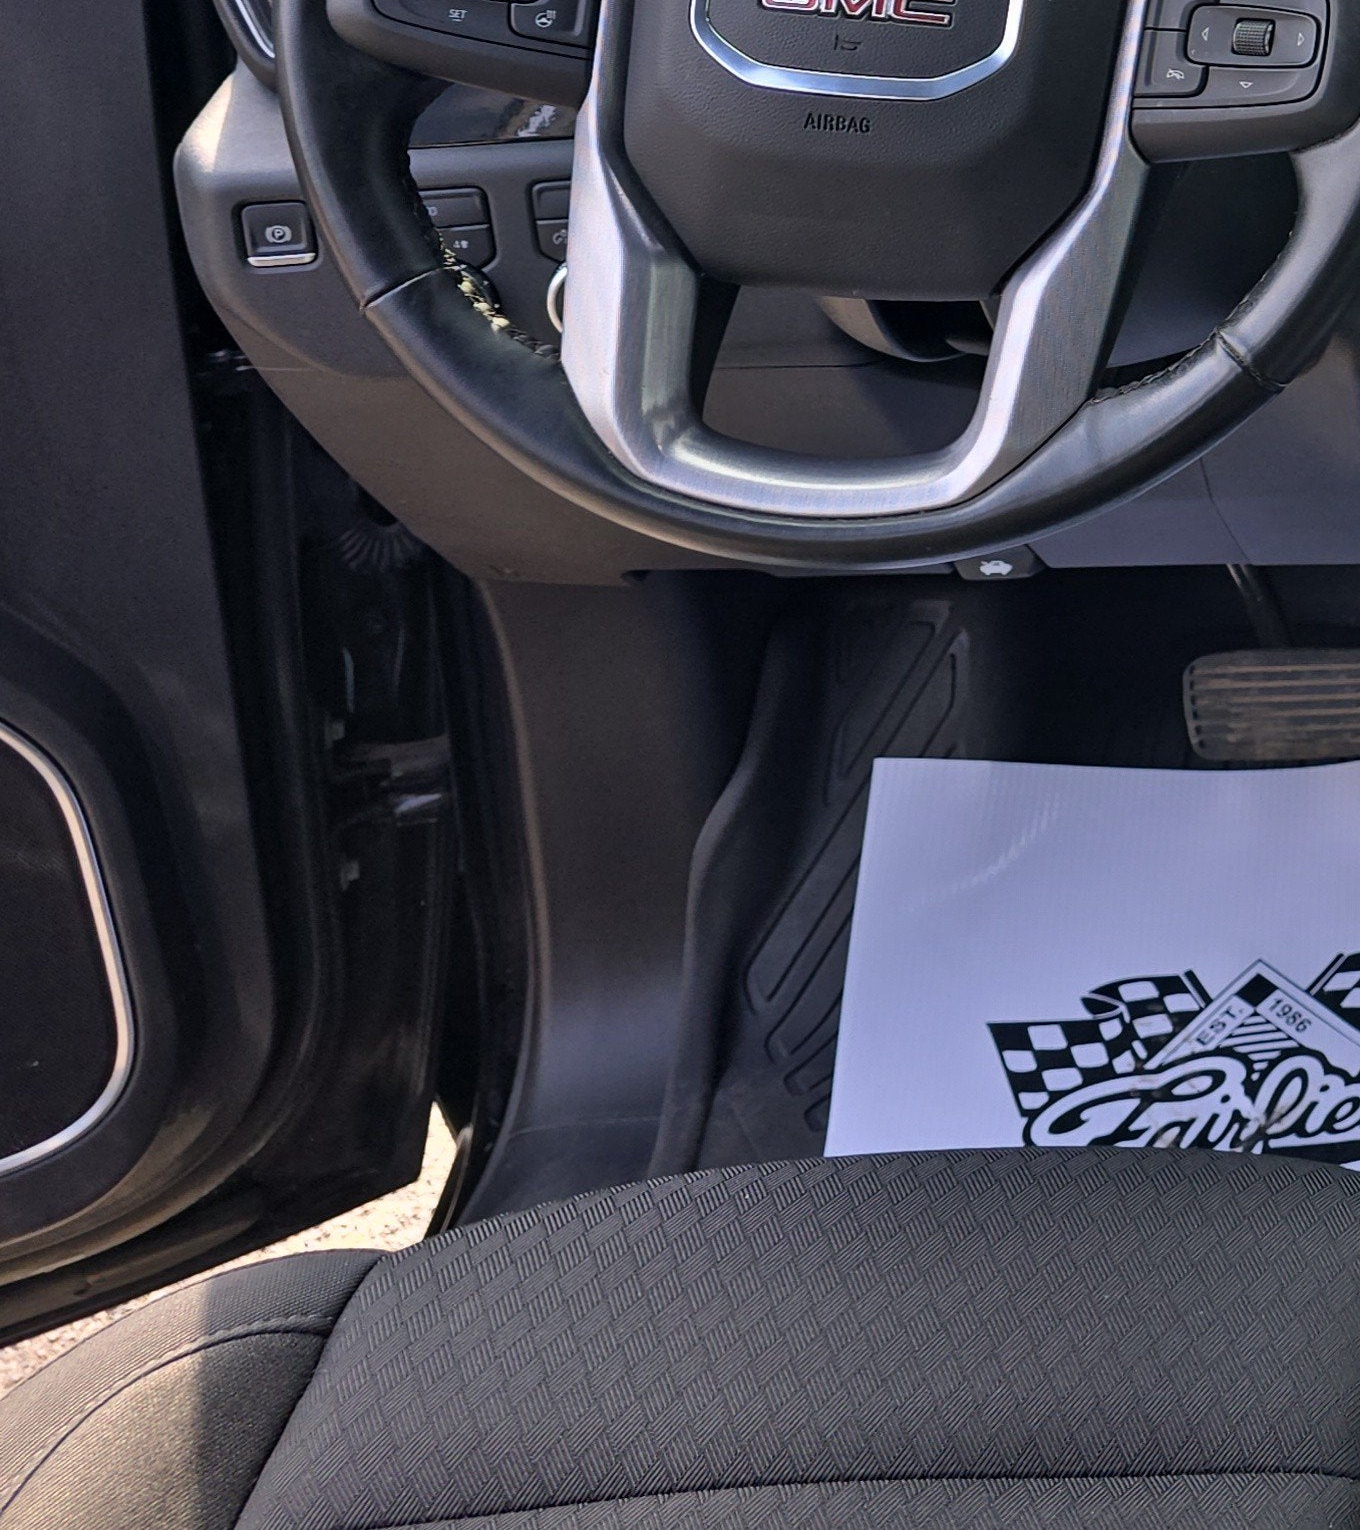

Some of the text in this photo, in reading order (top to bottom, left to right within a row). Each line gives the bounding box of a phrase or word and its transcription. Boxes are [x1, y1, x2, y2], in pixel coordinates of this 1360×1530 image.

[448, 8, 468, 20] SET
[803, 111, 872, 134] AIRBAG
[1195, 996, 1314, 1047] EST. 1986
